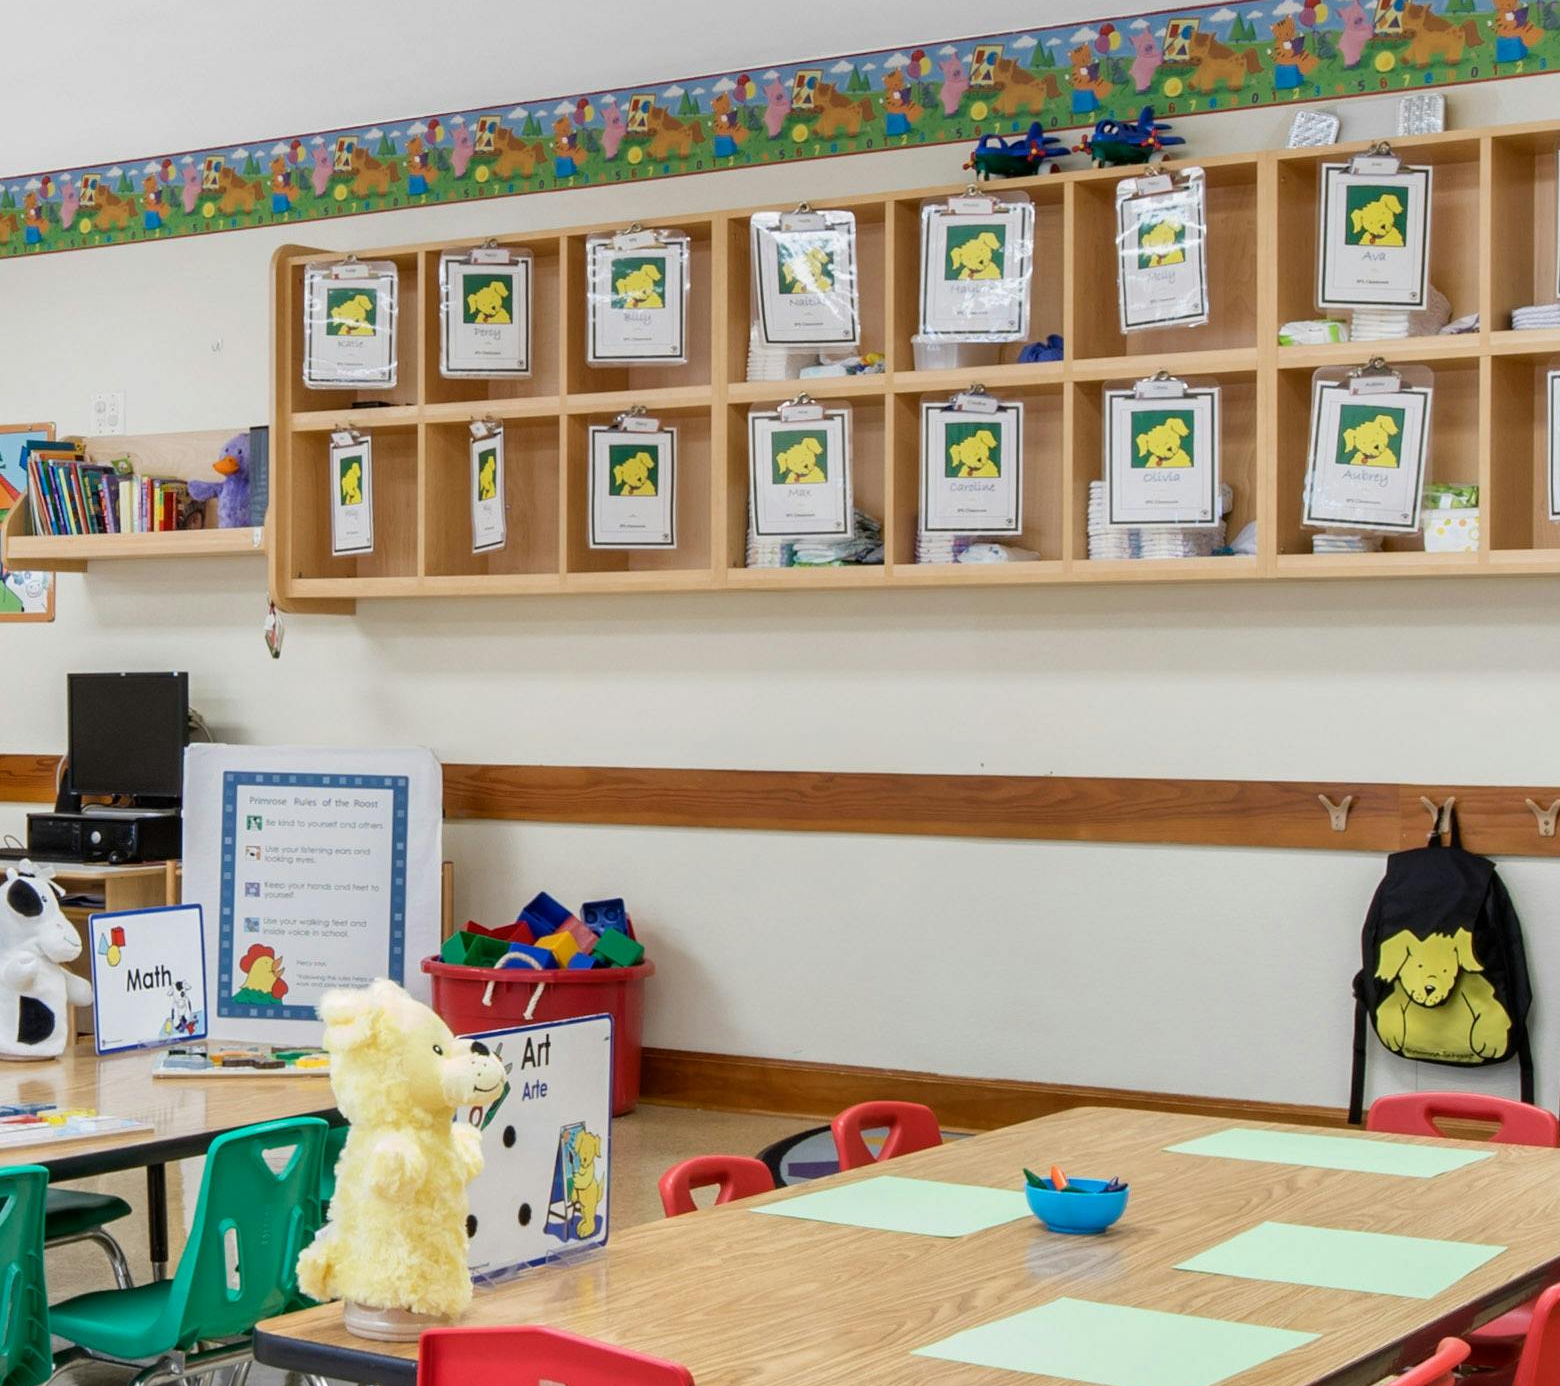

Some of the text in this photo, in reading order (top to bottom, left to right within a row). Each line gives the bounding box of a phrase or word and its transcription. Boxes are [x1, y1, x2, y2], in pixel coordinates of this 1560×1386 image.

[1361, 252, 1386, 262] Ava
[1143, 473, 1182, 483] Olivia
[1342, 470, 1389, 487] Aubrey
[950, 483, 996, 494] Caroline
[249, 796, 379, 809] Primrose Rules of the Roost
[126, 964, 173, 992] Math
[521, 1033, 551, 1070] Art
[522, 1079, 548, 1101] Arte
